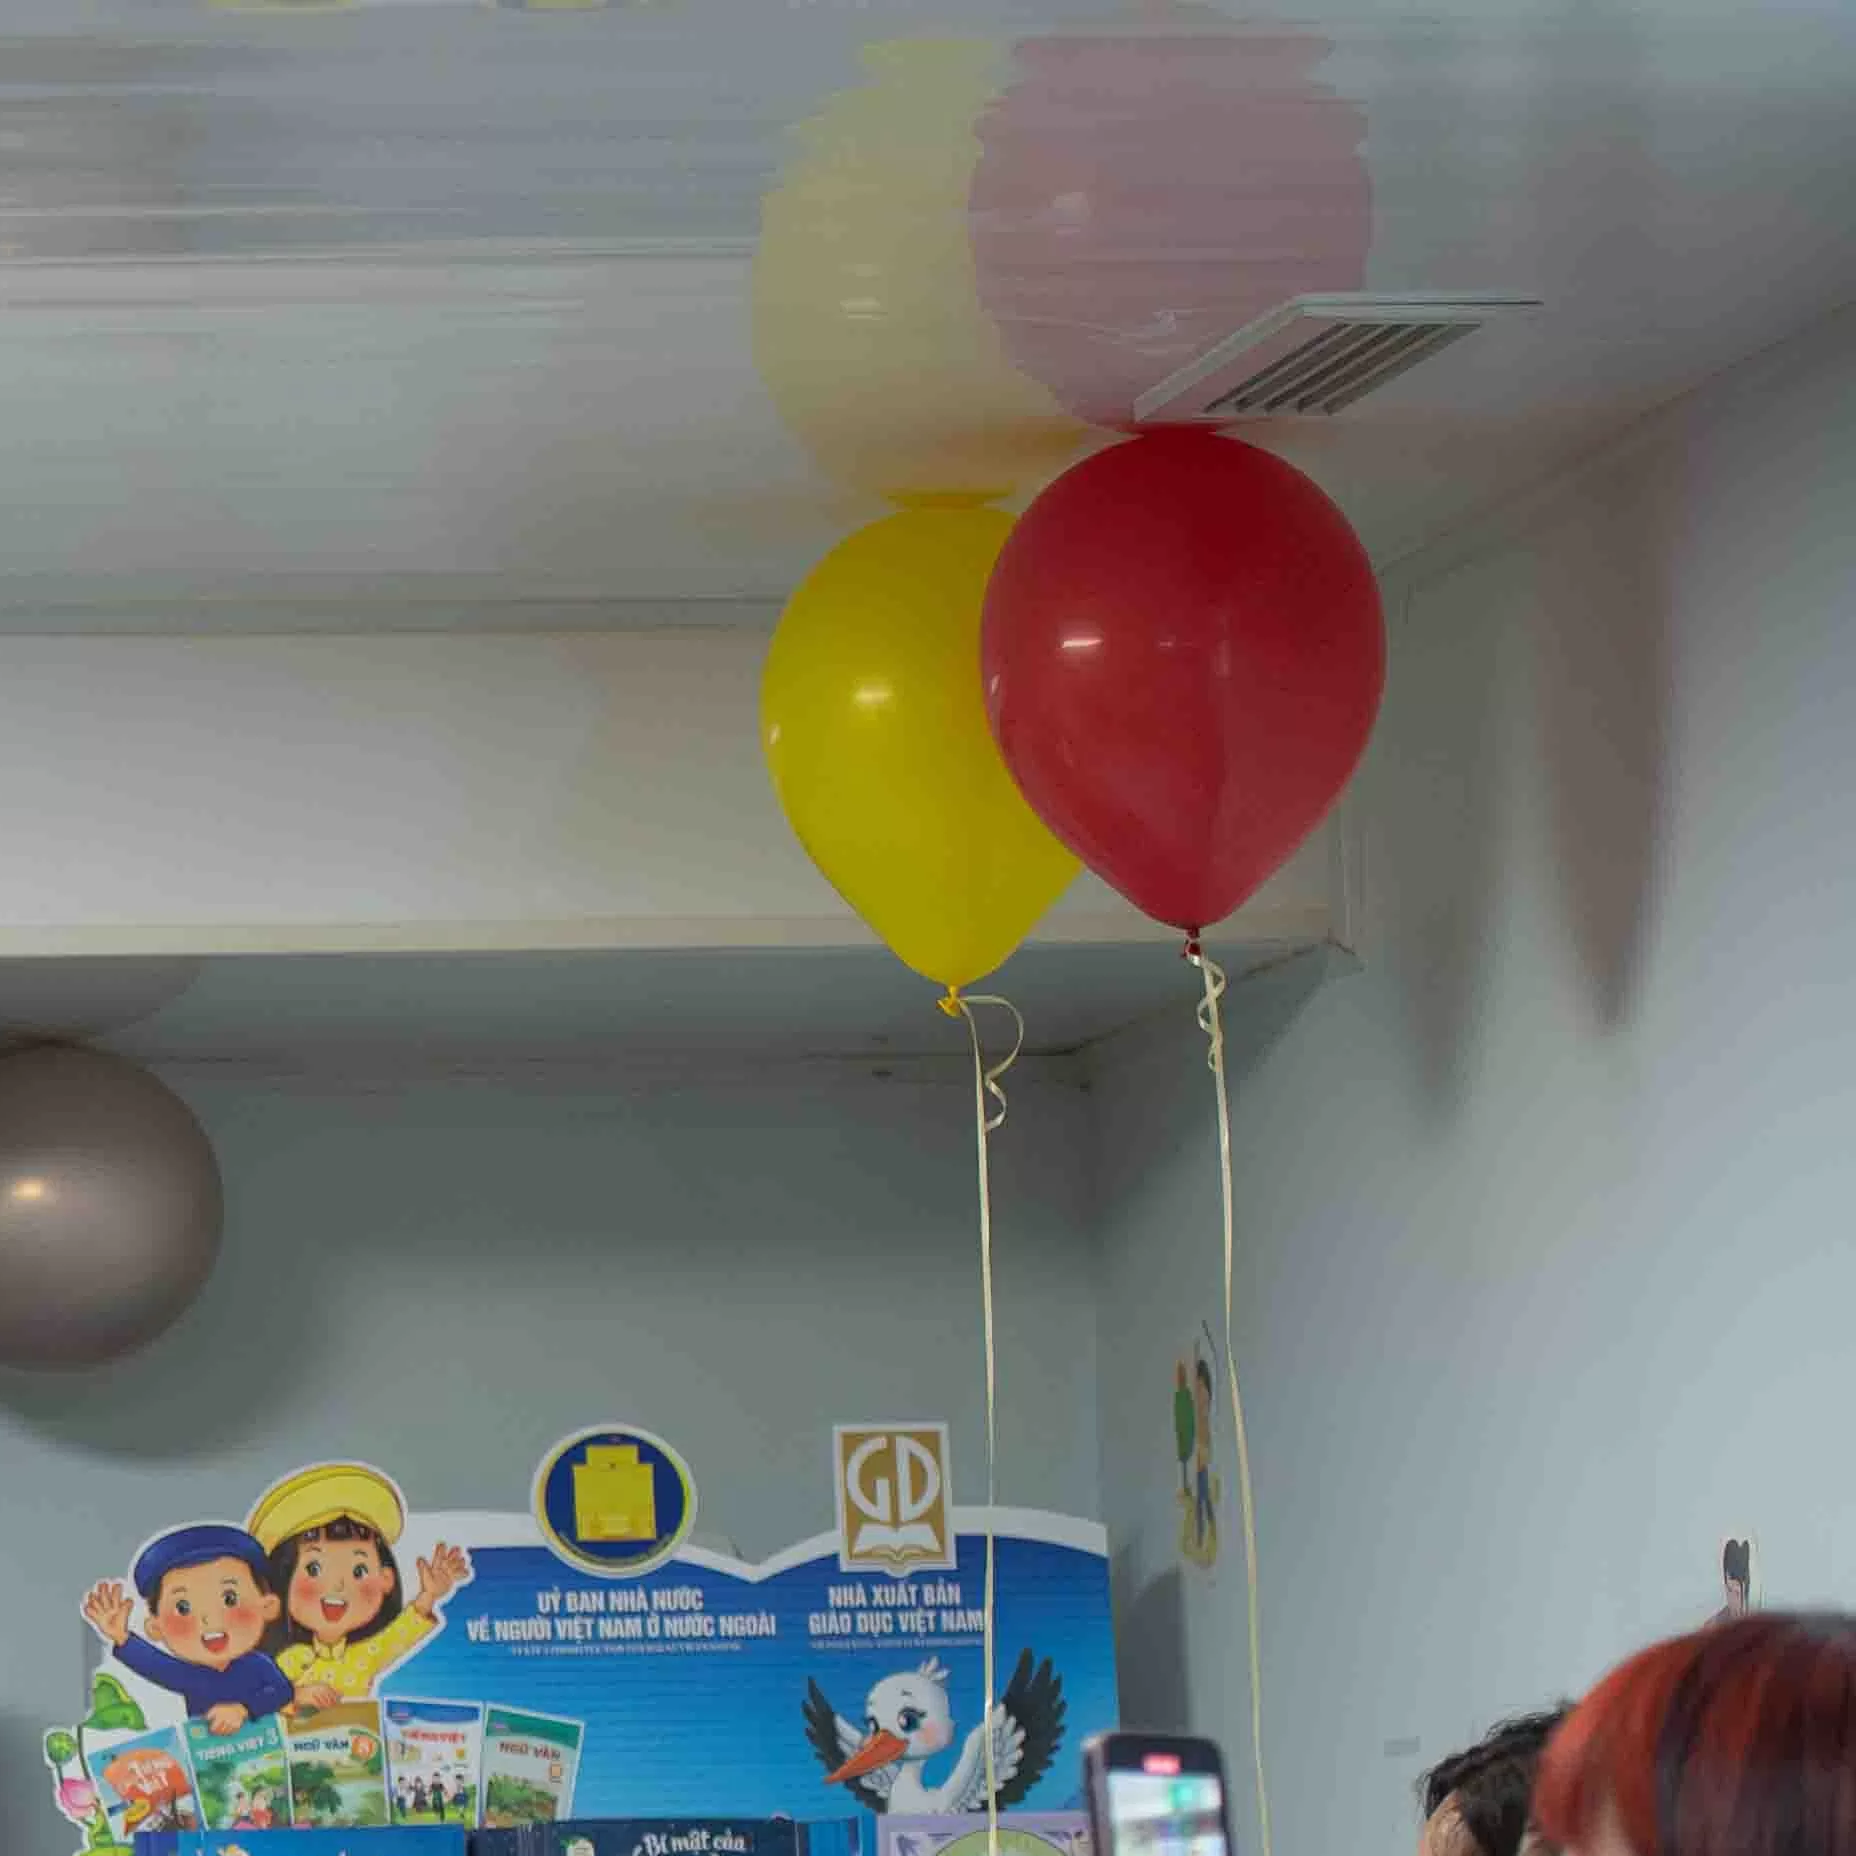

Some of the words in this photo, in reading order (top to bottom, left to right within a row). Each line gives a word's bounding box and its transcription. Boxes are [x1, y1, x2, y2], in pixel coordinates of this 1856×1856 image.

[566, 1592, 605, 1613] BAN
[609, 1588, 649, 1613] NHÀ
[828, 1583, 867, 1608] NHÀ
[871, 1581, 919, 1607] XUẤT
[556, 1616, 595, 1645] VIỆT
[599, 1618, 643, 1640] NAM
[720, 1611, 776, 1638] NGOÀI
[808, 1609, 851, 1635] GIÁO
[856, 1612, 894, 1639] DỤC
[898, 1607, 937, 1637] VIỆT
[941, 1610, 985, 1632] NAM
